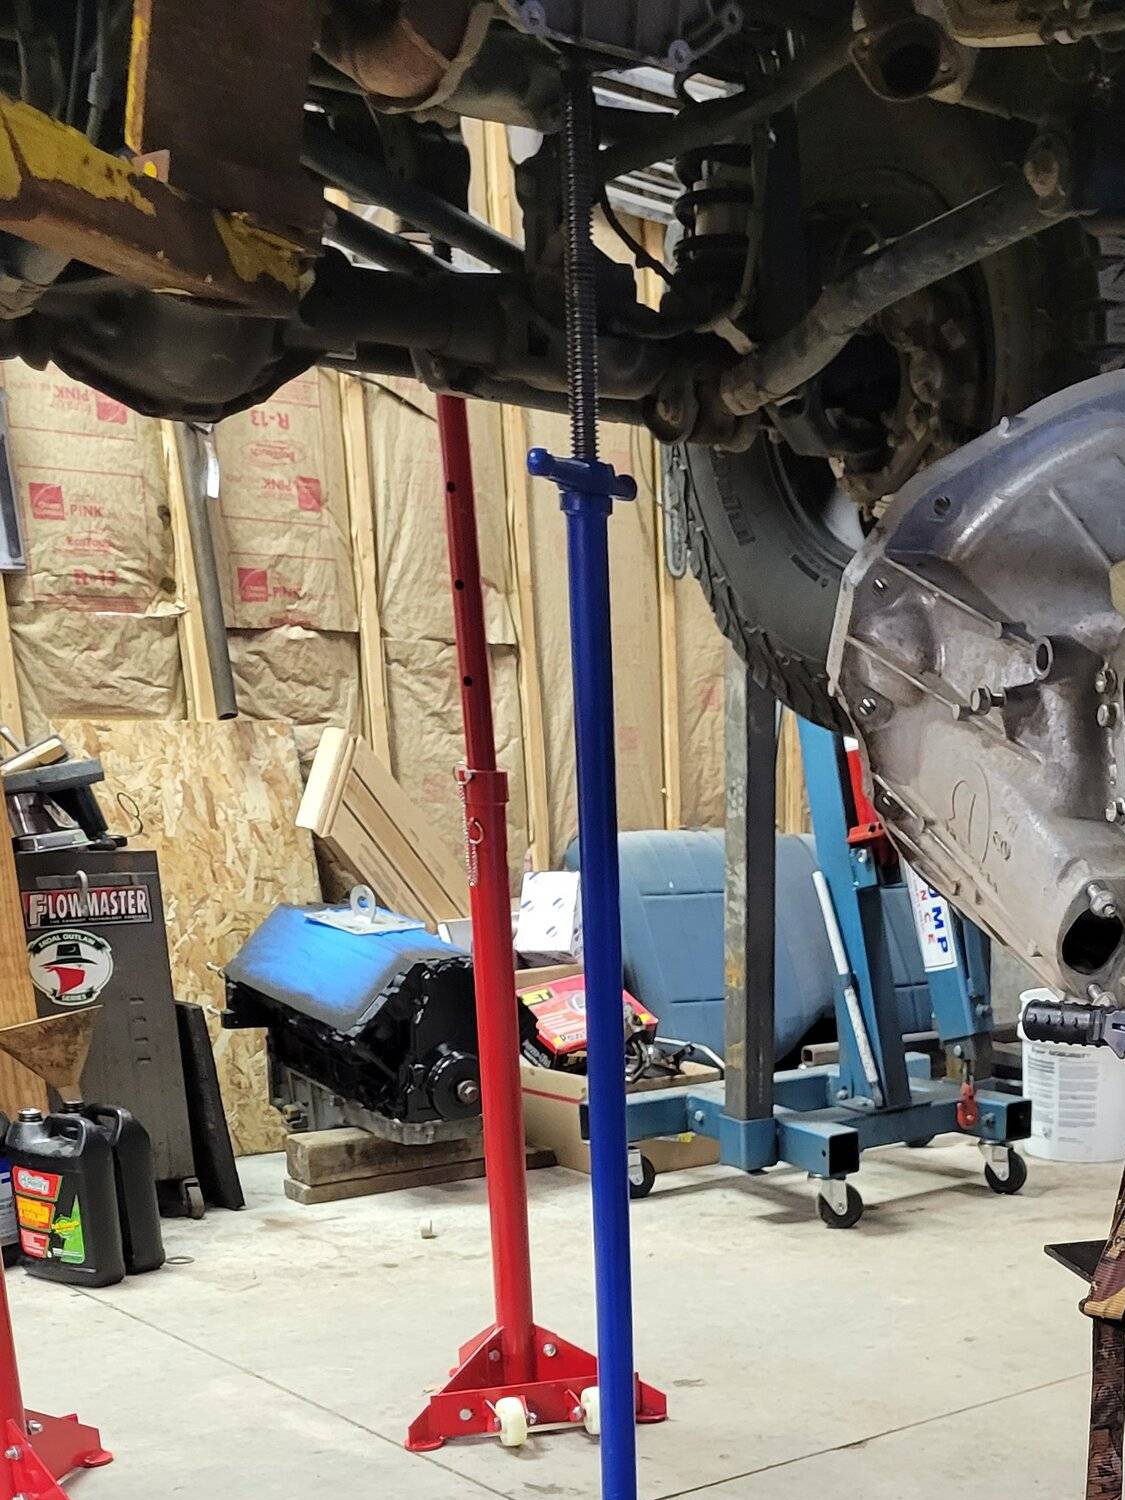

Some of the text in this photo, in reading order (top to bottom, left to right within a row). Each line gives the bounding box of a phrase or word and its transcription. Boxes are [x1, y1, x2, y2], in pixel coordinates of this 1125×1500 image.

[251, 410, 289, 430] R-13
[70, 504, 104, 518] PINK
[72, 569, 118, 587] R-13
[29, 889, 149, 927] FLOWMASTER
[62, 932, 97, 946] OUTLAW
